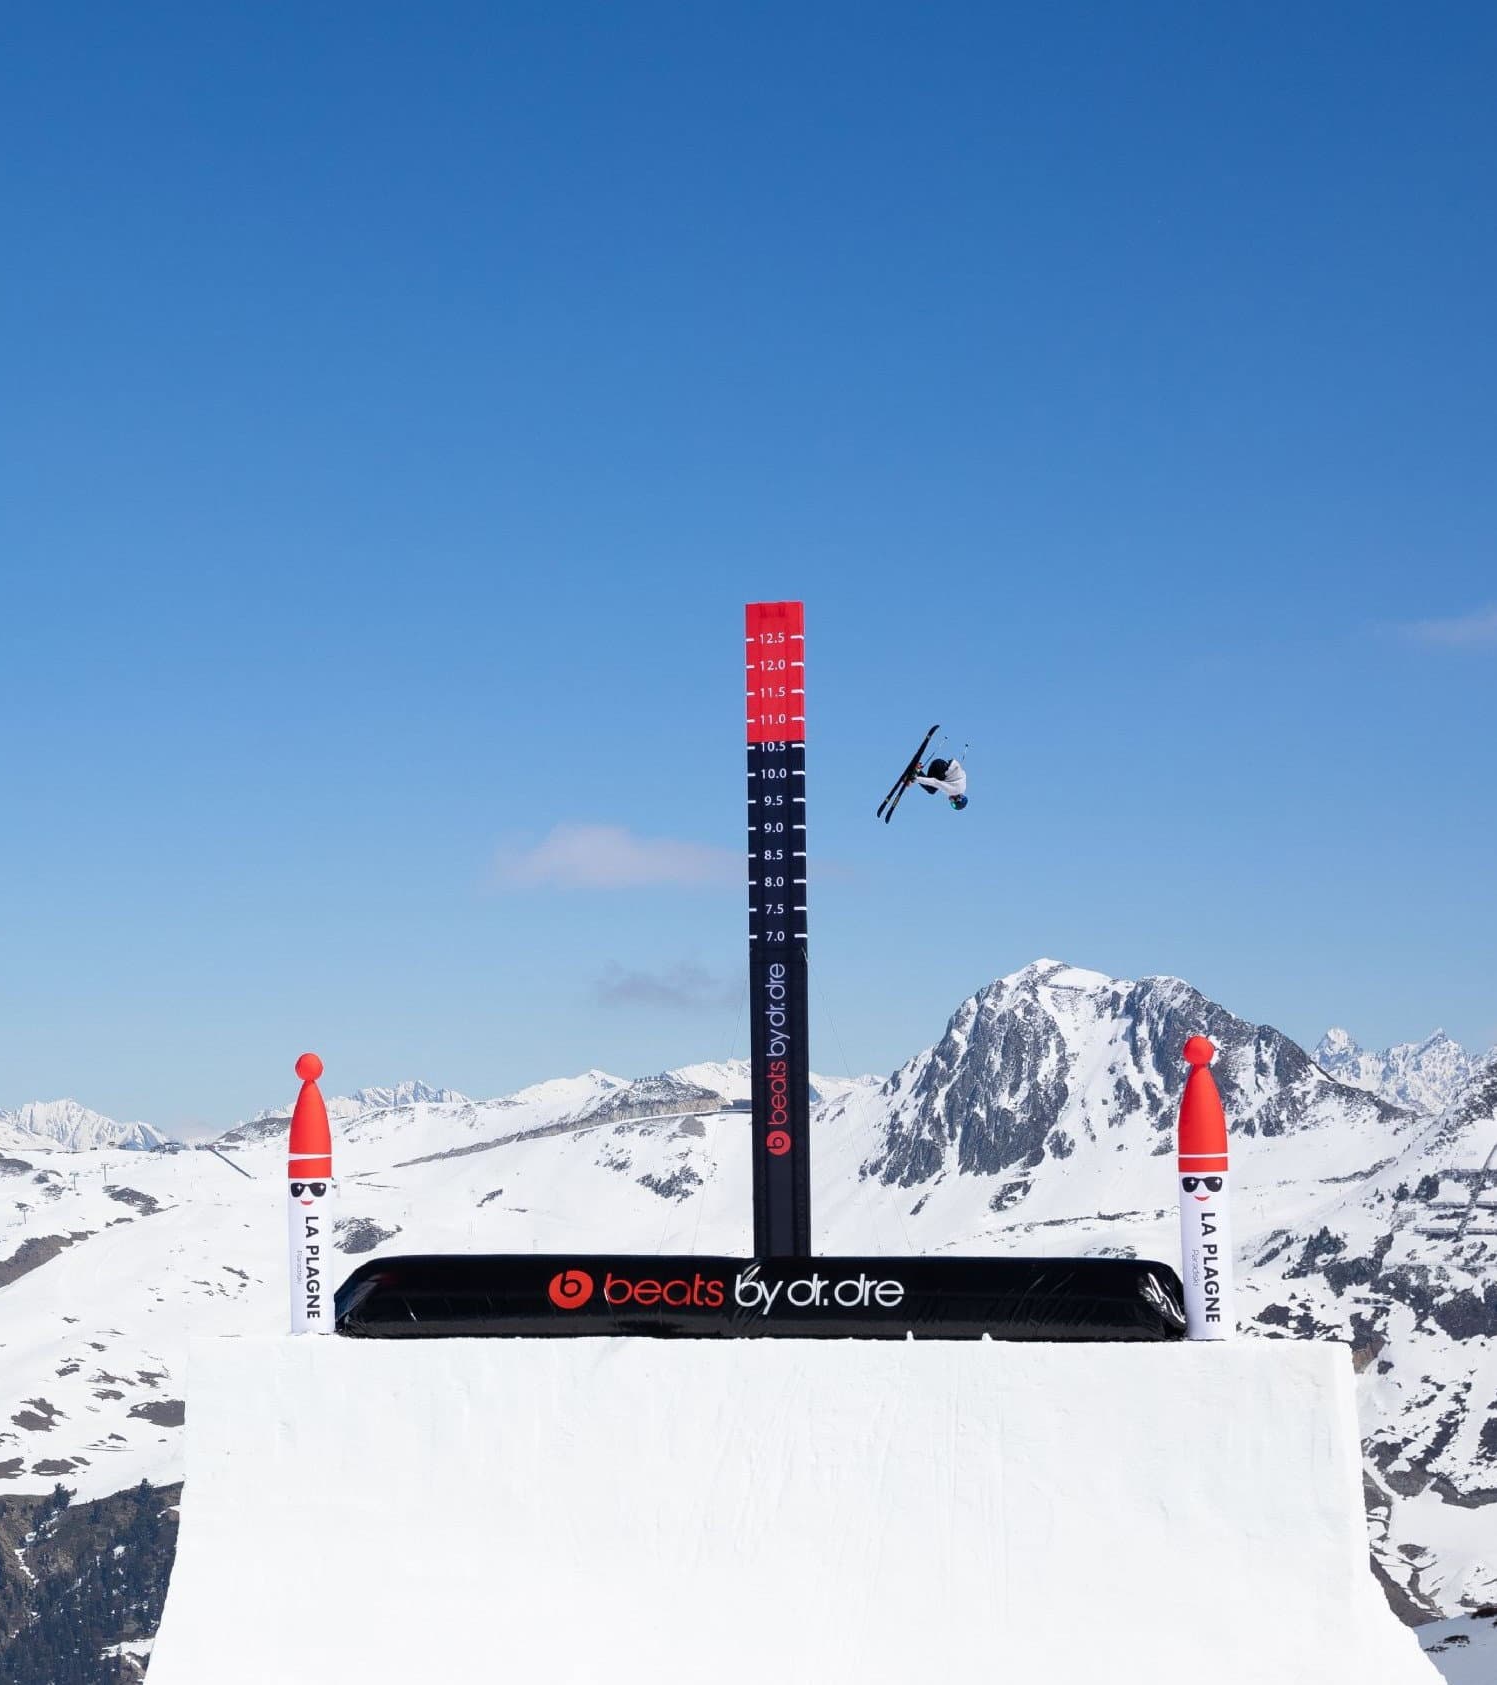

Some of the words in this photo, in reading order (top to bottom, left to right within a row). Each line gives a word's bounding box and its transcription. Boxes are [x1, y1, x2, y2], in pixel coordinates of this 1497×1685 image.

[759, 632, 785, 644] 12.5
[760, 659, 786, 671] 12.0
[760, 686, 786, 698] 11.5
[760, 713, 786, 725] 11.0
[760, 741, 786, 752] 10.5
[761, 768, 787, 779] 10.0
[764, 795, 783, 806] 9.5
[764, 822, 784, 833] 9.0
[764, 849, 783, 860] 8.5
[764, 876, 784, 887] 8.0
[765, 903, 784, 914] 7.5
[766, 930, 785, 942] 7.0
[765, 963, 786, 1000] dre
[766, 1029, 790, 1057] by
[767, 1060, 787, 1125] beats
[305, 1216, 319, 1239] LA
[1201, 1212, 1217, 1237] LA
[306, 1245, 320, 1319] PLAGNE
[1203, 1244, 1220, 1323] PLAGNE
[604, 1273, 724, 1307] beats
[735, 1274, 784, 1315] by
[834, 1273, 905, 1307] dre
